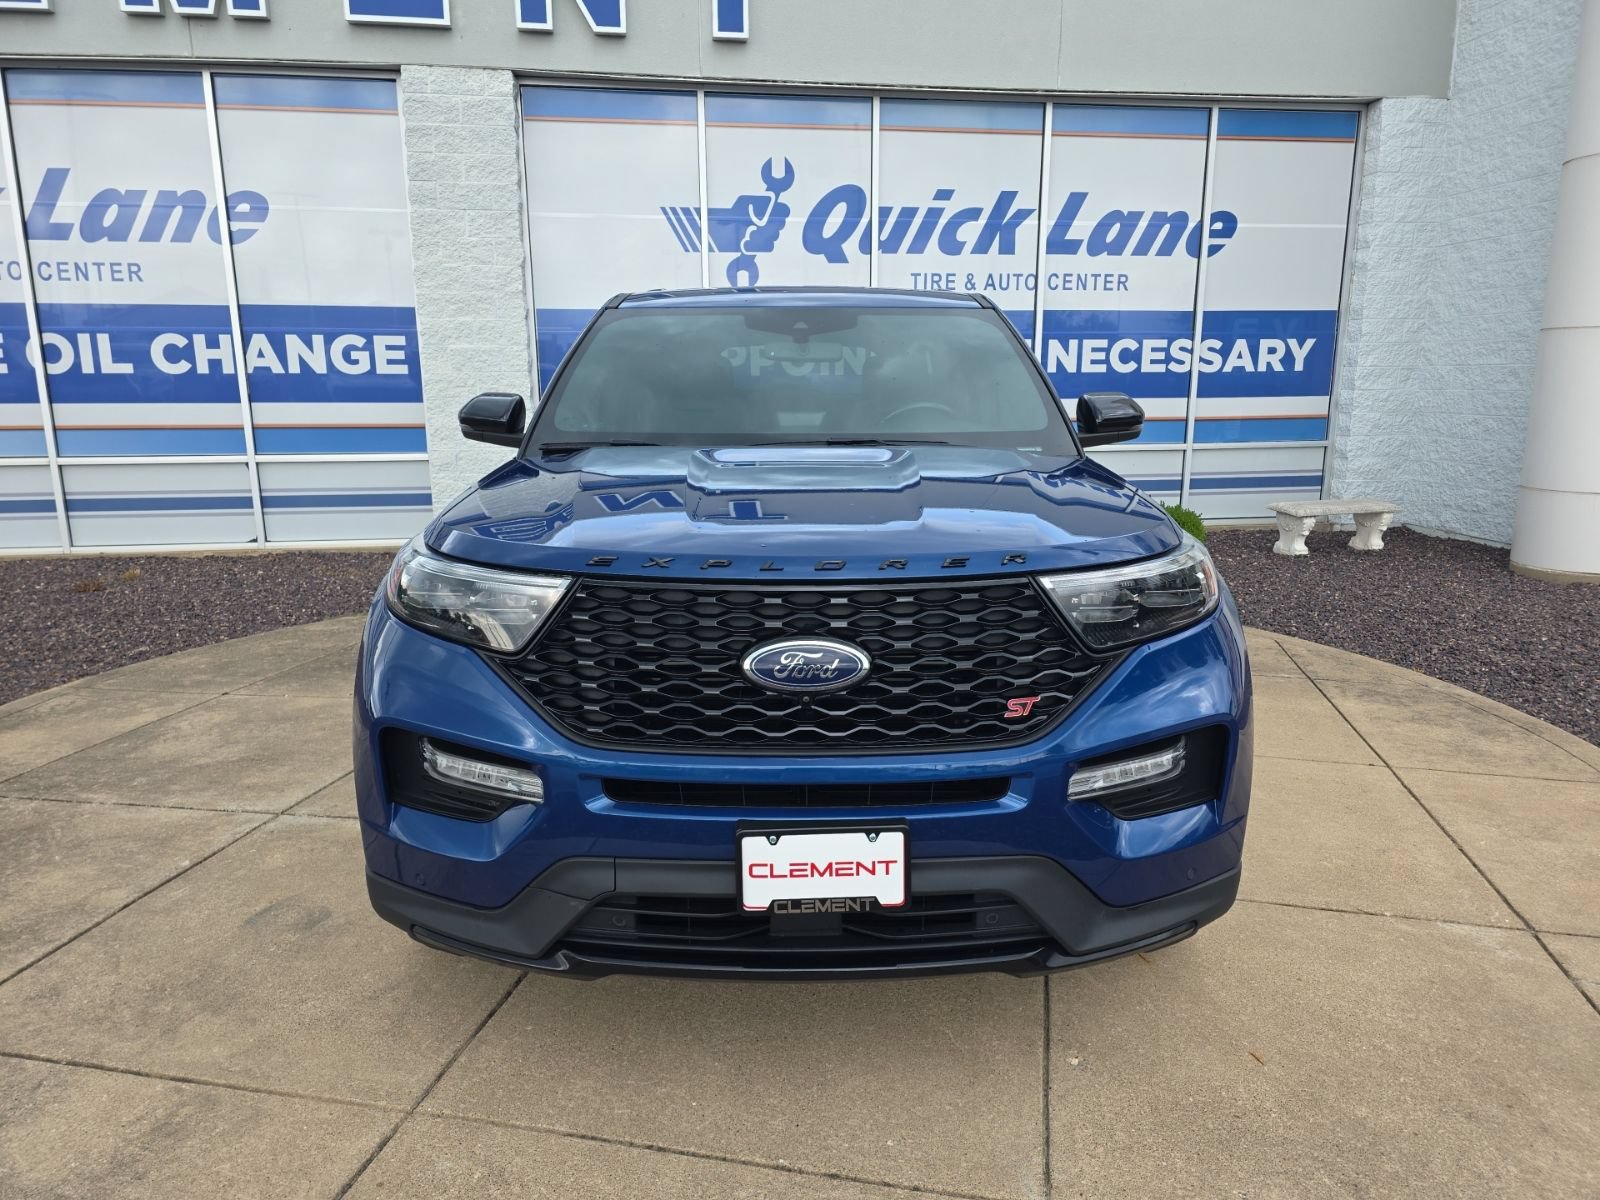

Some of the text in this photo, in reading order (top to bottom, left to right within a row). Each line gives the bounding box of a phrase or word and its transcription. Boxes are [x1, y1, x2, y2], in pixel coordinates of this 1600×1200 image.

[25, 167, 269, 245] Lane
[802, 184, 1239, 264] Quick Lane
[37, 261, 144, 282] CENTER
[910, 272, 1129, 292] TIRE & AUTO CENTER
[25, 332, 134, 375] OIL
[150, 332, 409, 375] CHANGE
[1046, 338, 1317, 374] NECESSARY
[585, 552, 1028, 571] EXPLORER
[773, 651, 840, 679] Ford
[1004, 696, 1041, 718] ST
[748, 860, 898, 879] CLEMENT
[773, 897, 876, 914] CLEMENT
